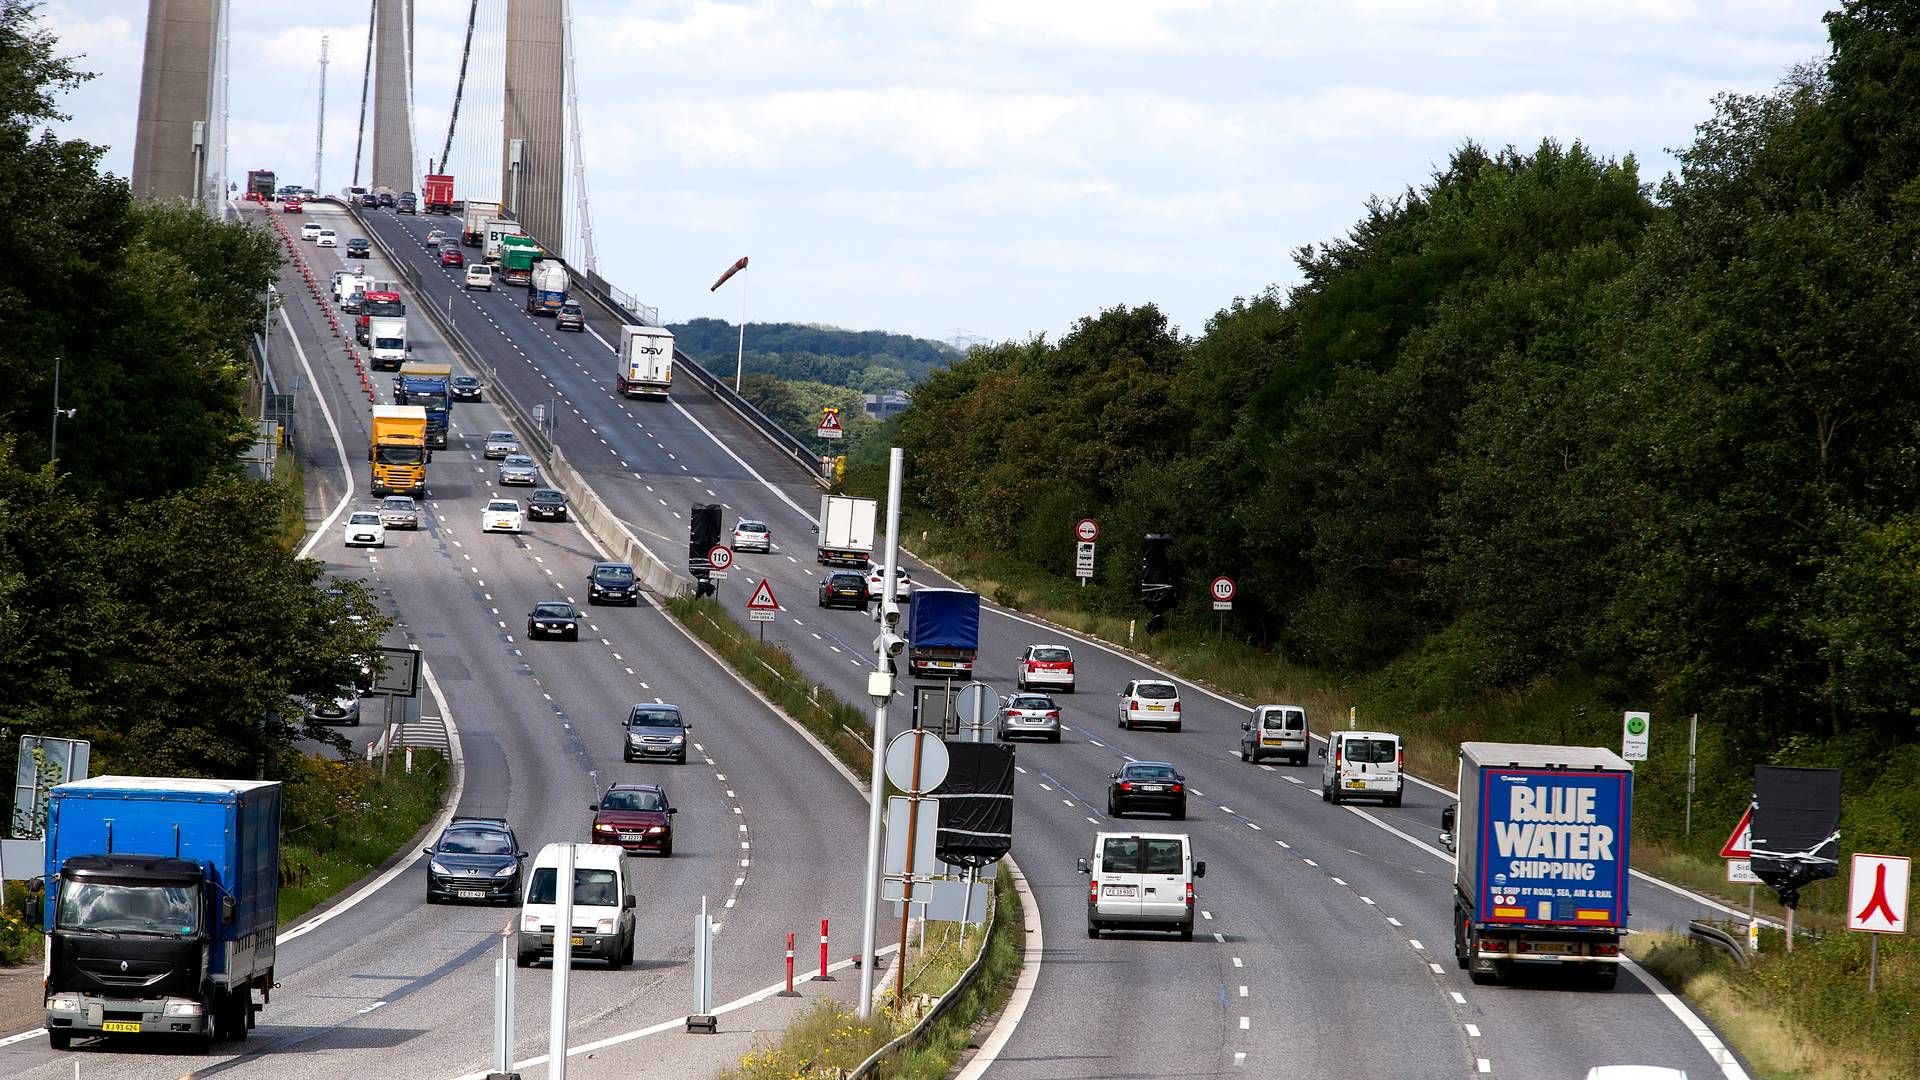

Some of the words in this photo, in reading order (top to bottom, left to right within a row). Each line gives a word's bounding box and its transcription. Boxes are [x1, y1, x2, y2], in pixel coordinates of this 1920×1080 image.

[640, 346, 664, 355] DSV
[713, 553, 728, 562] 110
[1216, 584, 1231, 593] 110
[1510, 786, 1597, 824] BLUE
[1494, 822, 1614, 860] WATER
[1509, 861, 1596, 880] SHIPPING
[1504, 887, 1520, 895] SHIP
[1533, 888, 1555, 897] ROAD,
[1556, 888, 1572, 898] SEA,
[1573, 889, 1586, 897] AIR
[1595, 890, 1612, 898] RAIL
